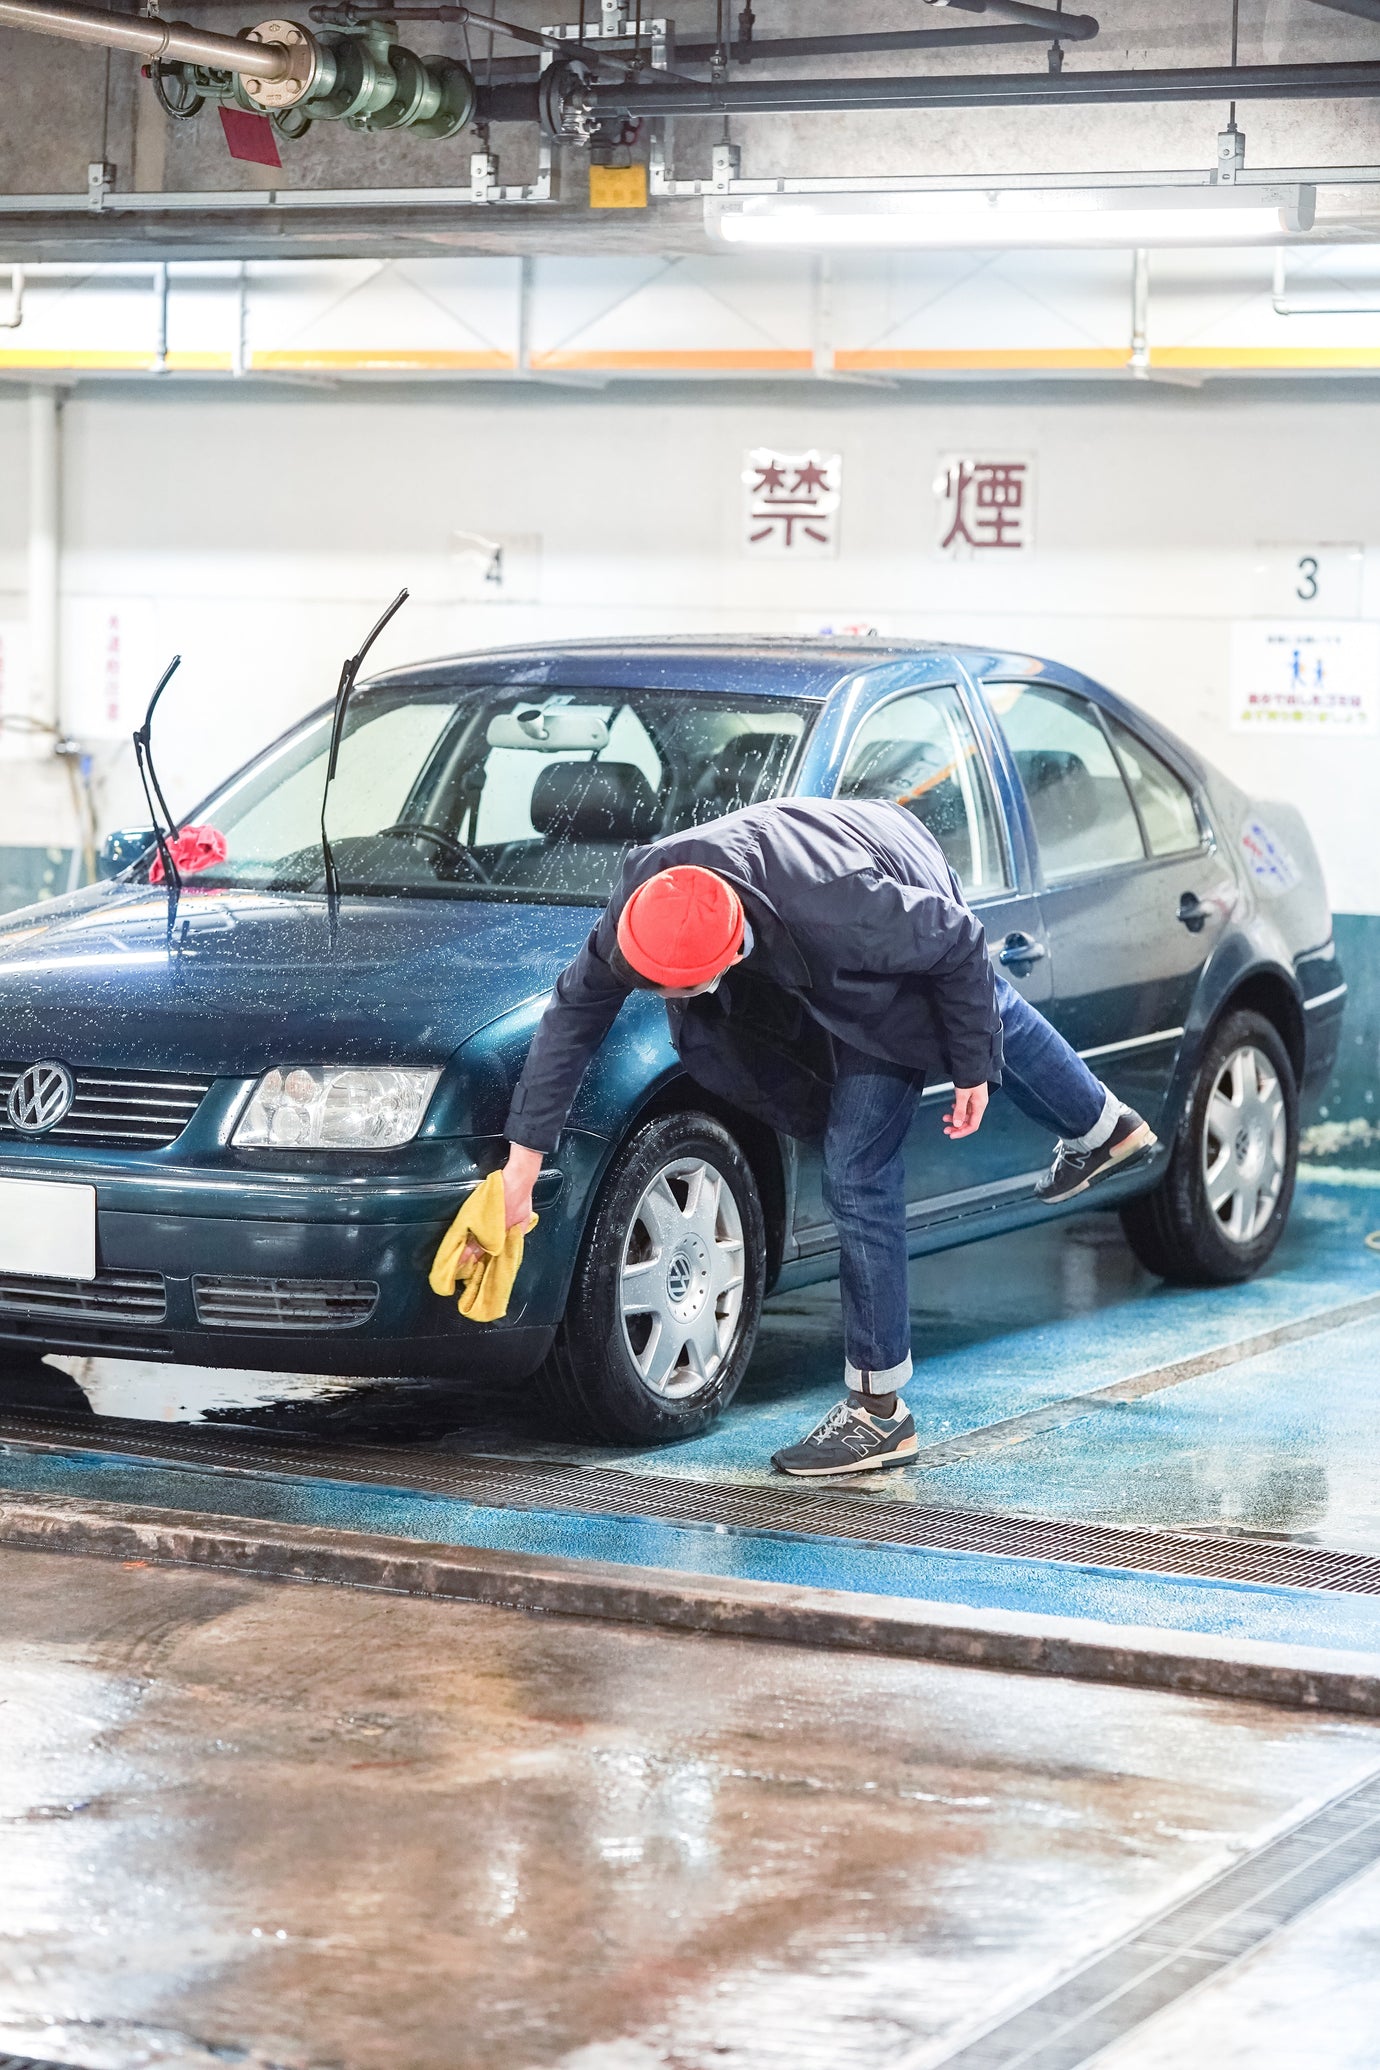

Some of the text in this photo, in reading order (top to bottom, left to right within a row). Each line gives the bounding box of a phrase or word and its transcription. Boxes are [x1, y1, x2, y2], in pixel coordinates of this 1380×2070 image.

[485, 546, 503, 588] 4
[1297, 557, 1318, 600] 3
[841, 1425, 882, 1458] N
